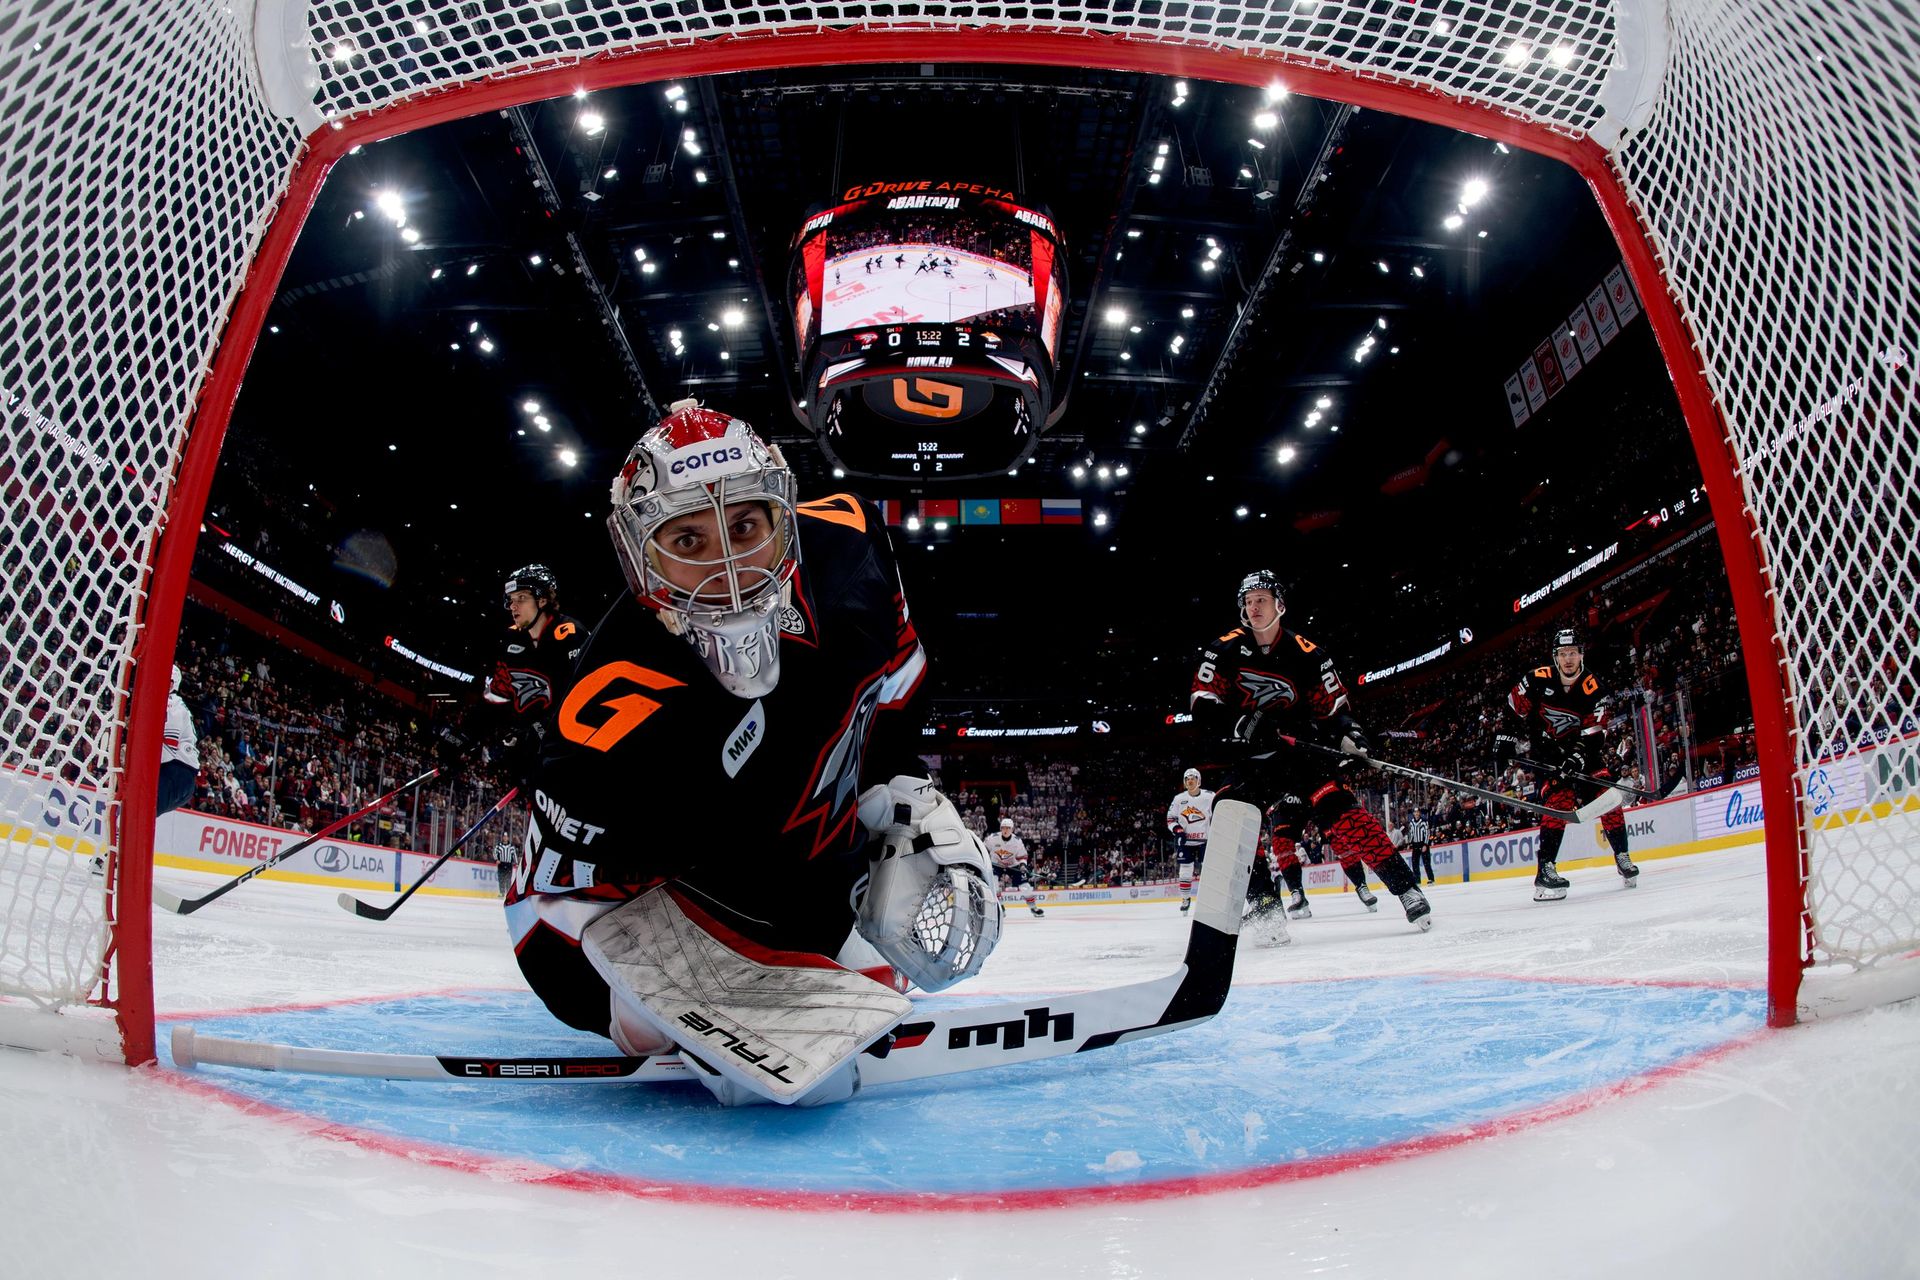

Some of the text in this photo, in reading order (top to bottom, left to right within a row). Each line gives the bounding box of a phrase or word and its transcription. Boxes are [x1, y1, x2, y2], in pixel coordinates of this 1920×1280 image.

[936, 182, 1015, 201] АРЕНА
[888, 333, 901, 346] 0
[916, 331, 942, 340] 15:22
[958, 333, 970, 346] 2
[918, 442, 938, 451] 15:22
[671, 447, 742, 474] согаз
[913, 462, 943, 471] 0 2
[1660, 507, 1669, 522] 0
[1690, 488, 1700, 503] 2
[1698, 520, 1716, 535] ХОККЕ
[219, 542, 255, 566] NERGY
[1197, 661, 1217, 683] 6
[1321, 671, 1340, 694] 2
[727, 720, 758, 761] МИР
[1700, 776, 1723, 789] согаз
[535, 789, 605, 845] ONBET
[1626, 820, 1655, 837] АНК
[199, 826, 283, 861] FONBET
[352, 855, 385, 873] LADA
[1308, 869, 1336, 884] FONBET
[677, 1011, 794, 1084] TRUE
[465, 1062, 549, 1078] CYBER
[566, 1064, 621, 1076] PRO
